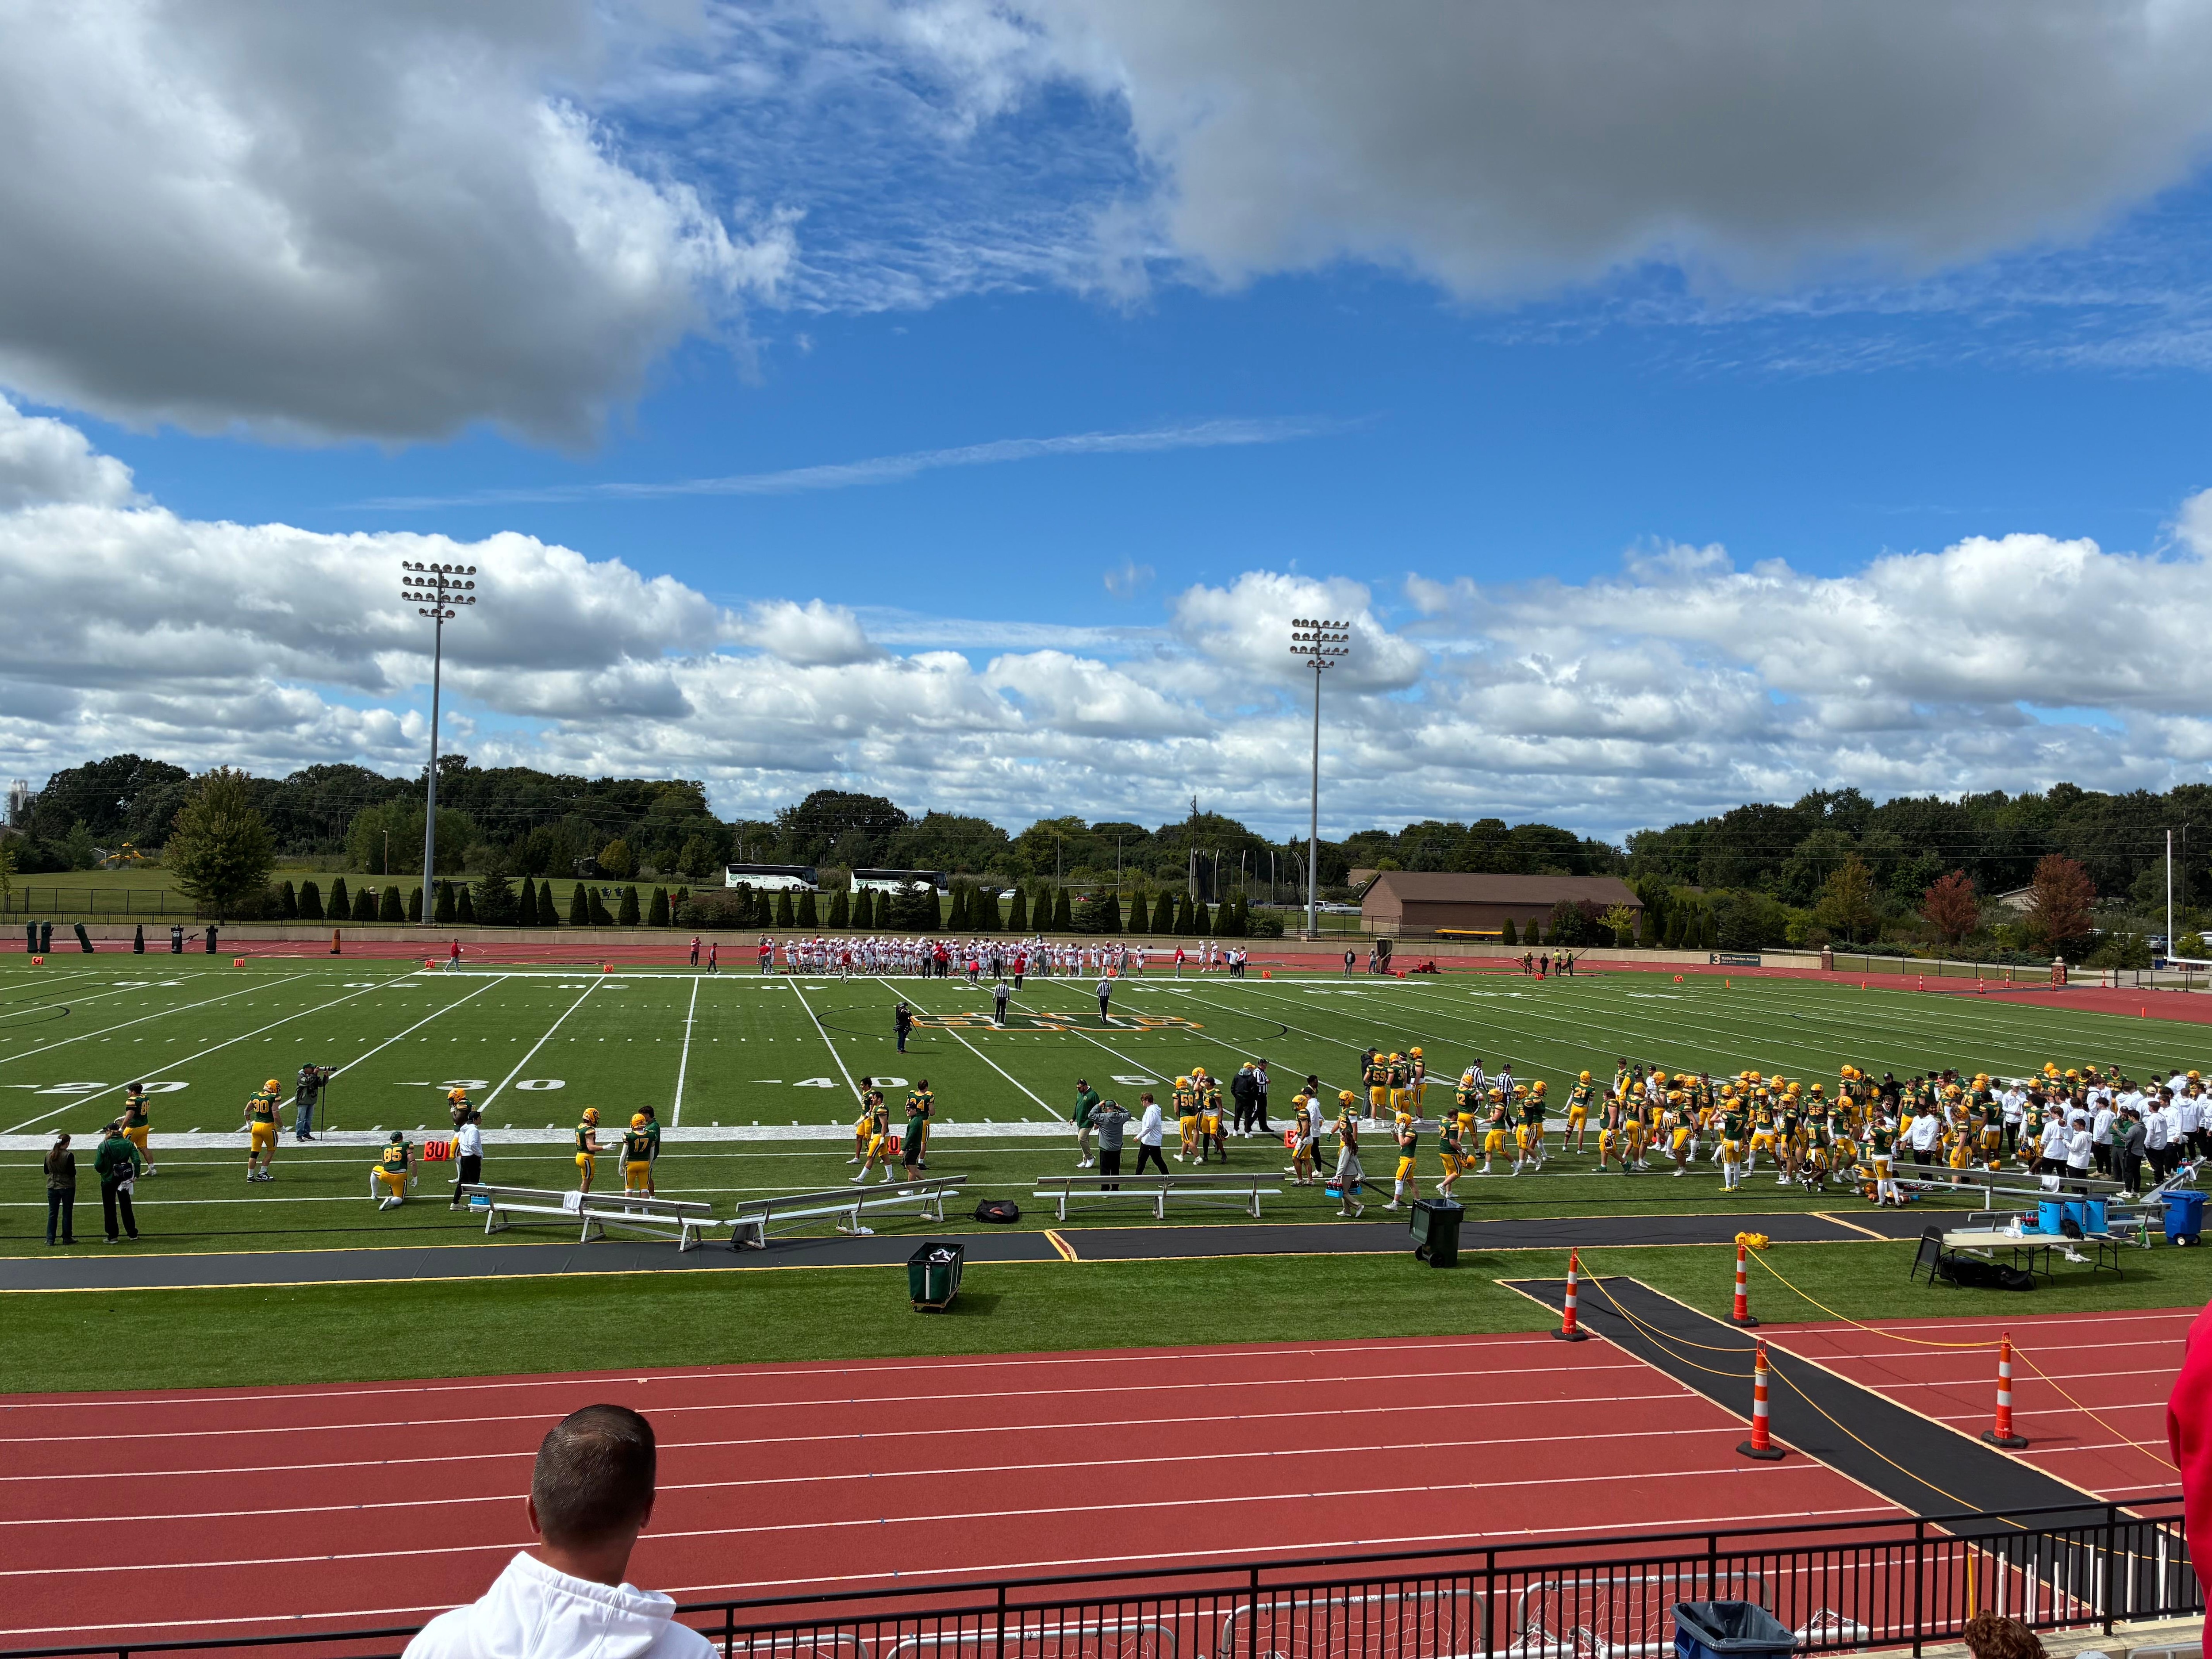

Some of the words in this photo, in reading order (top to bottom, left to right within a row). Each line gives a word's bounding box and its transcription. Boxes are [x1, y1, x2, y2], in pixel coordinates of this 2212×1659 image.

[1712, 954, 1720, 964] 3
[910, 1012, 1204, 1032] SNC
[1574, 1087, 1586, 1098] 21
[1850, 1084, 1862, 1095] 70
[1456, 1092, 1466, 1105] 12
[252, 1098, 269, 1114] 30
[1994, 1106, 2000, 1119] 7
[1734, 1119, 1743, 1132] 7
[2028, 1112, 2037, 1126] 12
[634, 1138, 649, 1152] 17
[888, 1136, 899, 1151] 0
[1883, 1135, 1893, 1148] 9
[383, 1147, 402, 1163] 85
[426, 1141, 445, 1158] 30
